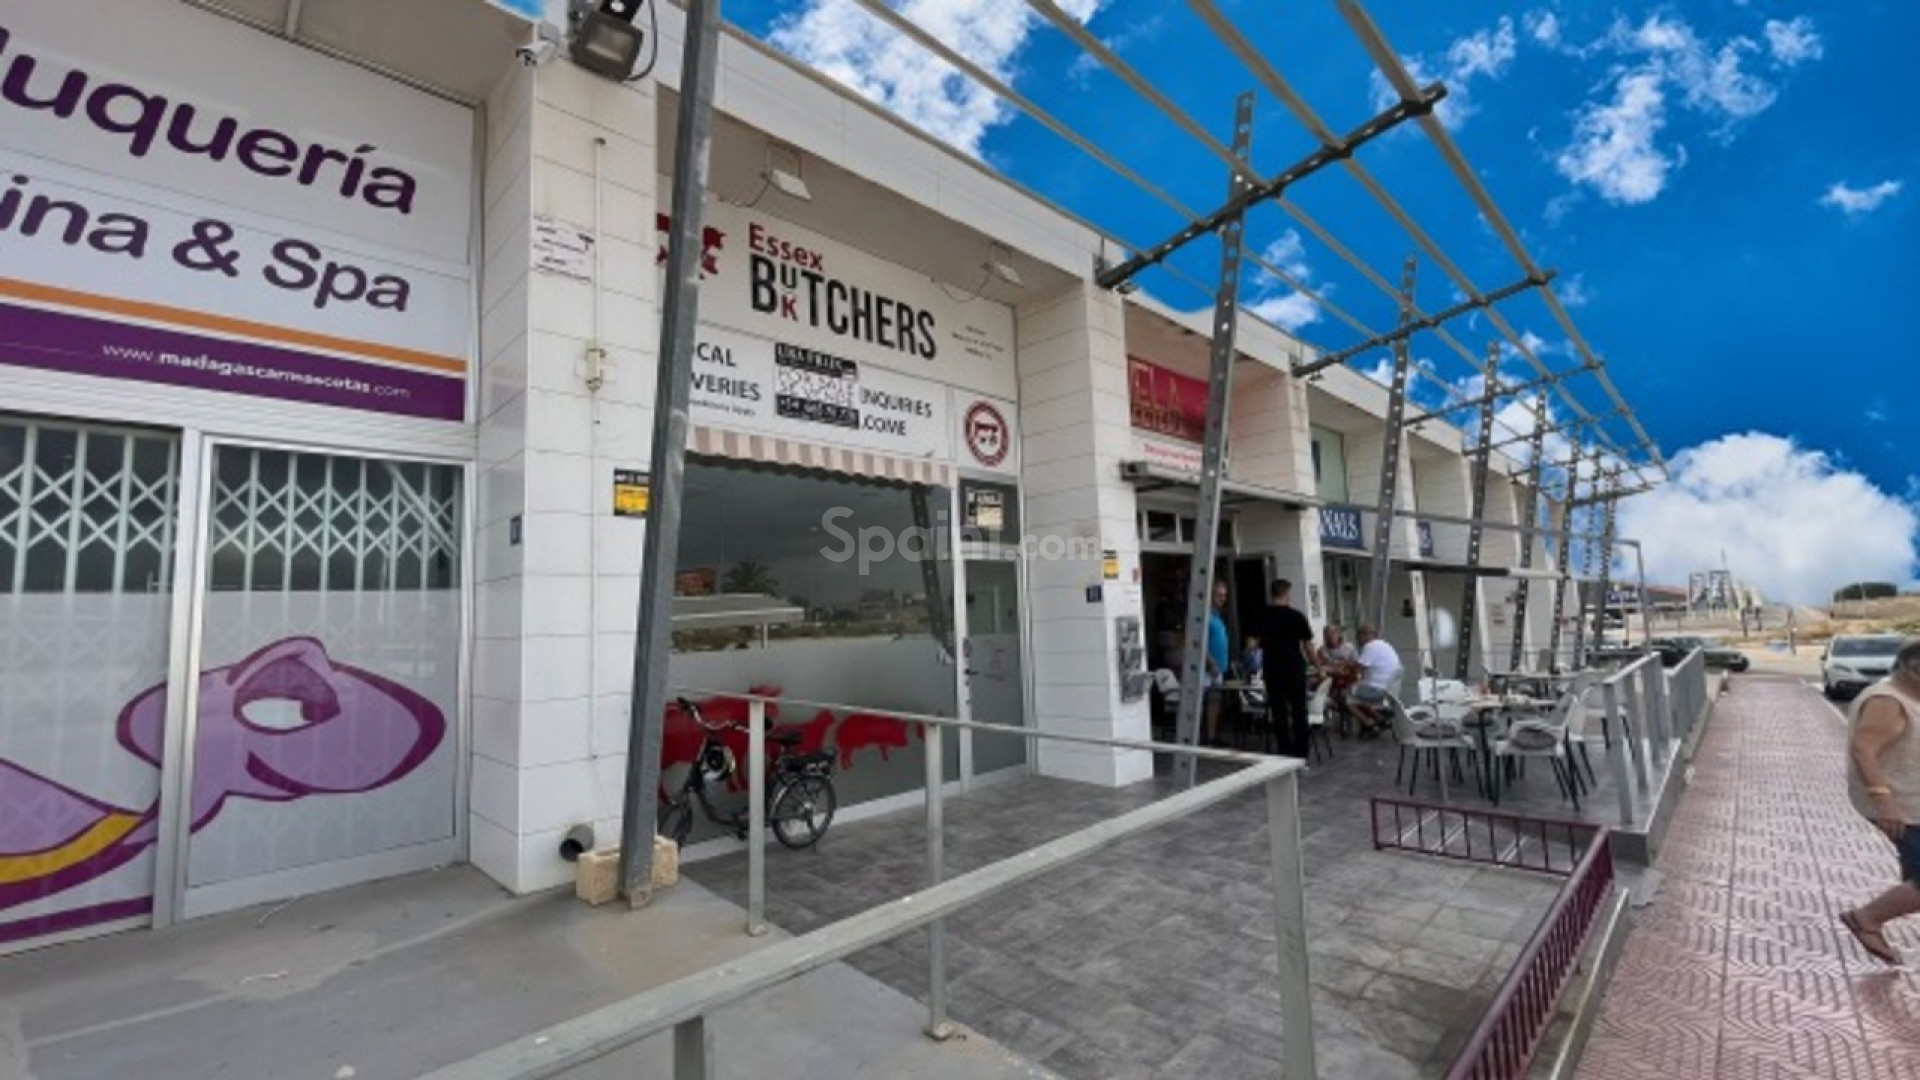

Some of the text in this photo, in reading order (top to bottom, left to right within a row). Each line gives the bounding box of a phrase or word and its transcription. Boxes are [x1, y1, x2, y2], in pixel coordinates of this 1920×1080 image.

[172, 218, 239, 277] &
[263, 239, 411, 312] Spa
[748, 222, 824, 271] Essex
[696, 342, 736, 367] CAL
